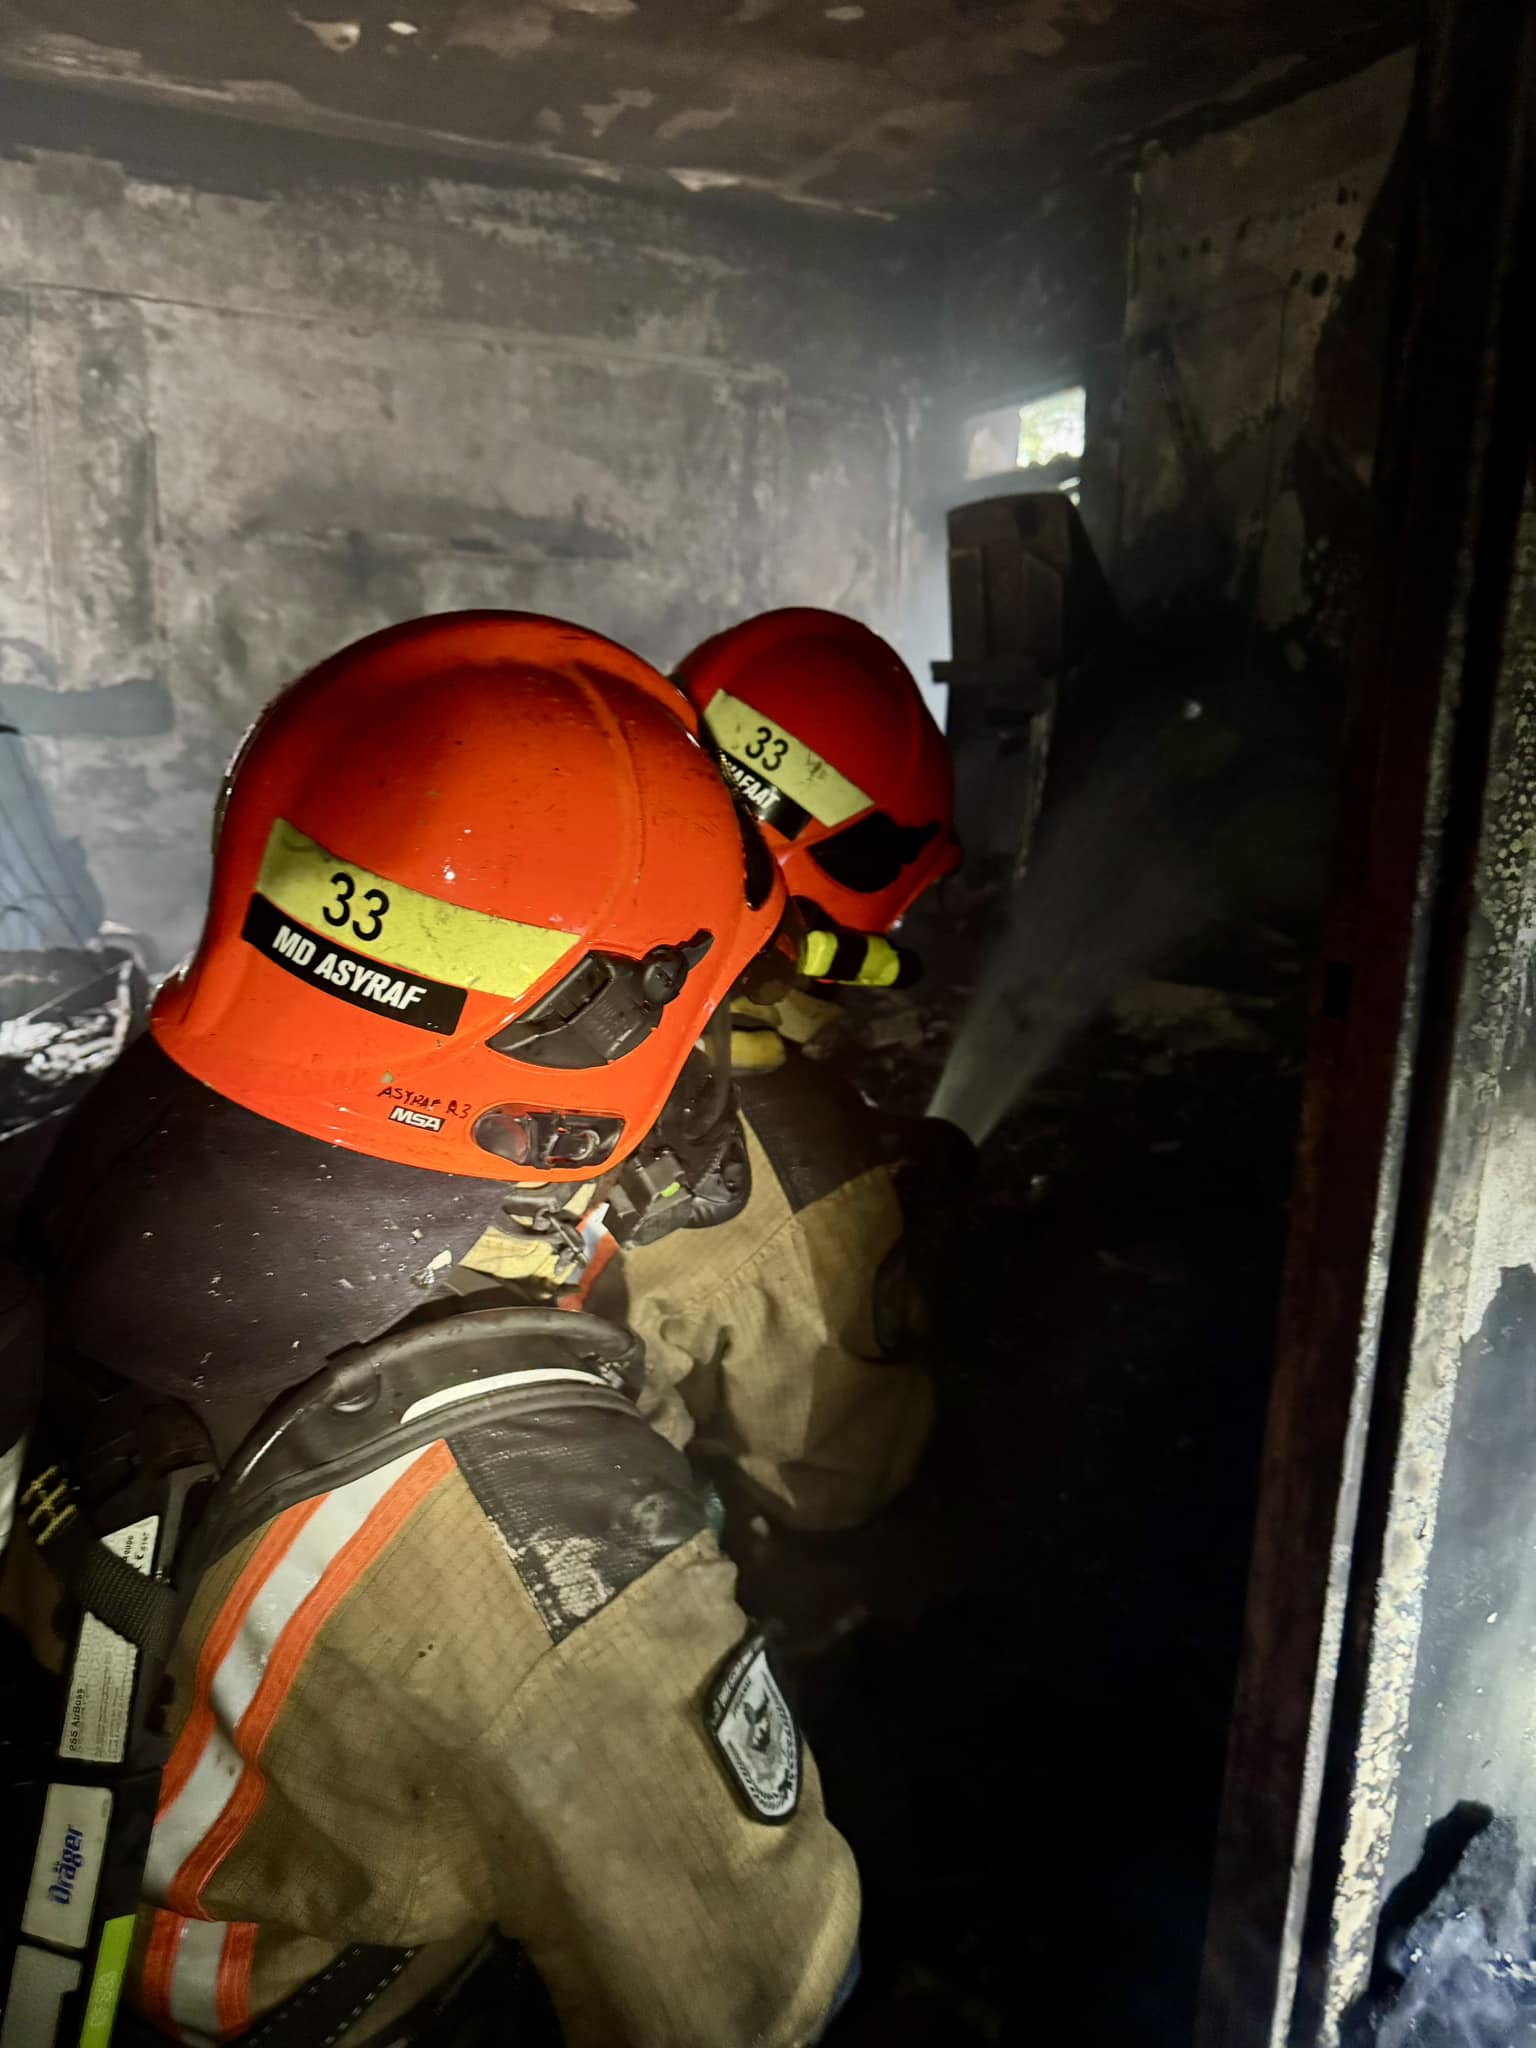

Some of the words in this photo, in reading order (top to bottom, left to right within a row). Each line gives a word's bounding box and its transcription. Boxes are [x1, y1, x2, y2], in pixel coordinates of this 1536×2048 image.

[744, 726, 790, 772] 33
[322, 872, 390, 942] 33
[272, 925, 316, 967] MD
[315, 953, 427, 1011] ASYRAF
[392, 1107, 443, 1131] MSA
[71, 1687, 85, 1727] AirBoss
[48, 1824, 84, 1905] Dräger
